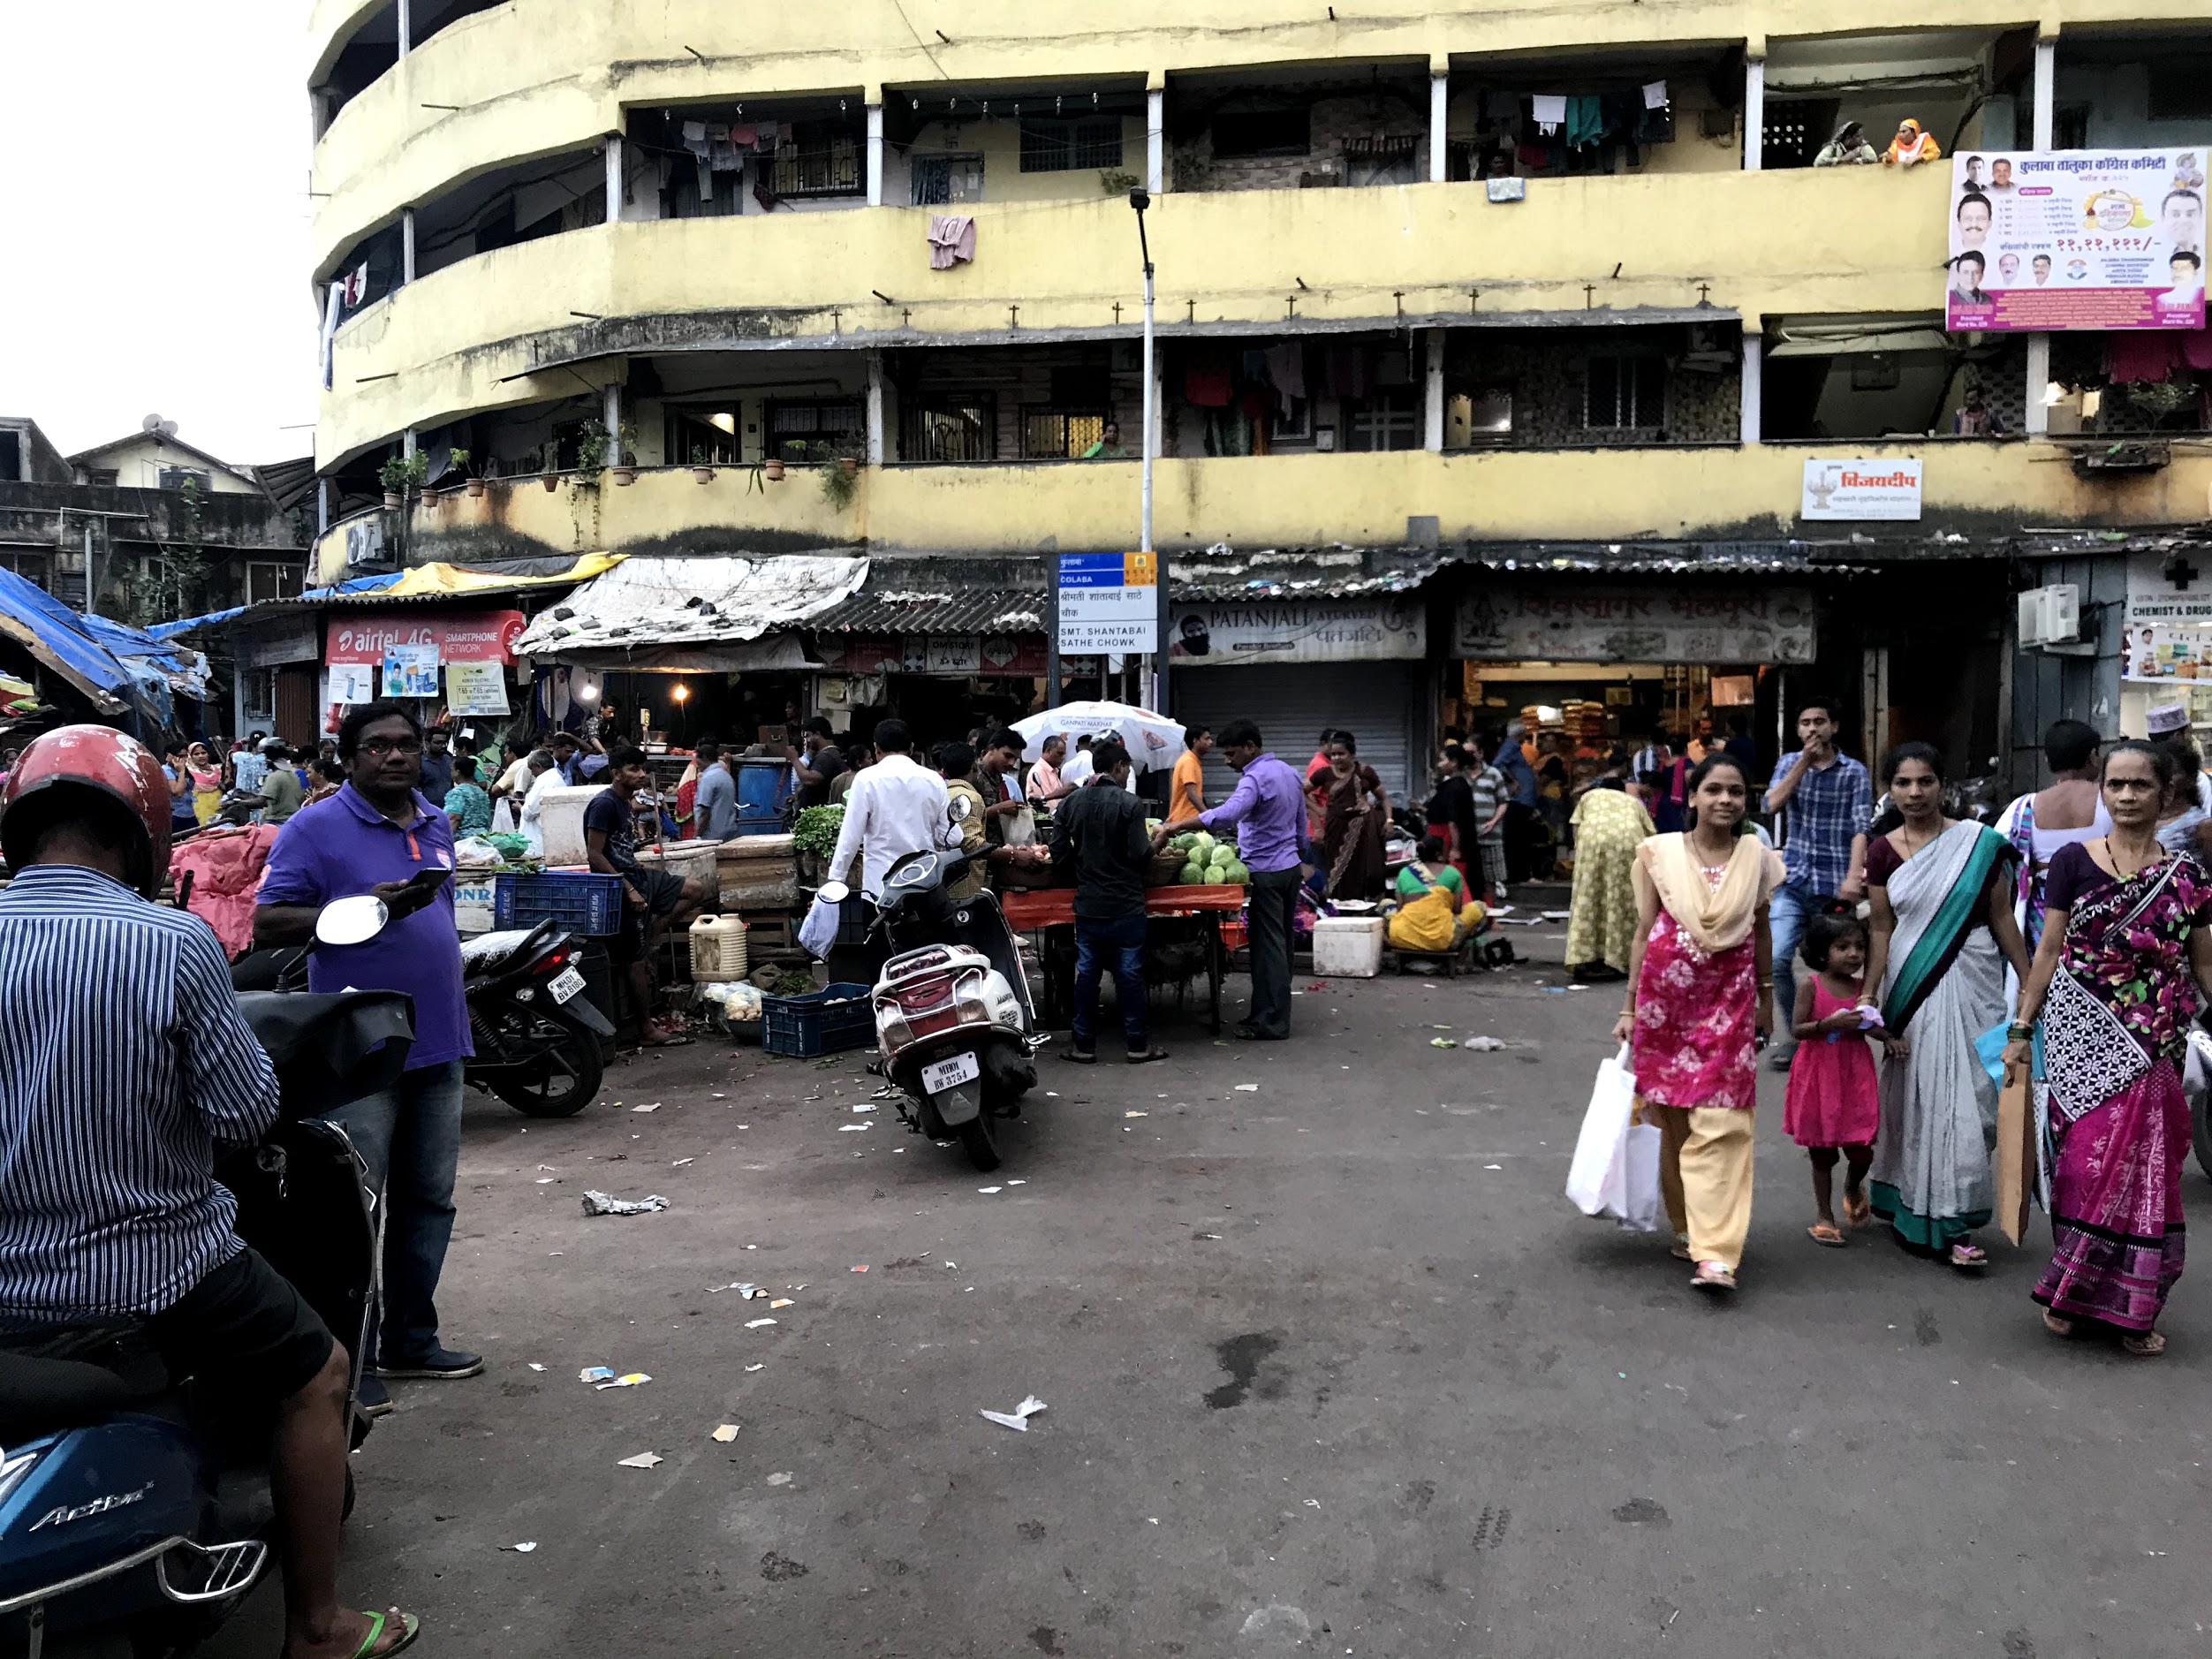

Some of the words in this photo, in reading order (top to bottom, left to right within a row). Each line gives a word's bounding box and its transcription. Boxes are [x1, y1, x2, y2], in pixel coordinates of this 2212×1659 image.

[2020, 160, 2054, 175] कुलाबा
[2057, 159, 2093, 174] तालुका
[2132, 155, 2166, 170] कमिटी
[1841, 471, 1916, 488] विजयदीप
[1060, 575, 1093, 584] COLABA
[1060, 590, 1085, 602] श्रीमती
[1088, 589, 1122, 602] शांताबाई
[1126, 589, 1142, 600] साठे
[2132, 606, 2175, 617] CHEMIST
[2177, 606, 2184, 616] &
[1210, 608, 1311, 631] PATANJALI
[1087, 626, 1147, 636] SHANTABAI
[444, 632, 498, 642] SMARTPHONE
[1097, 638, 1136, 647] CHOWK
[444, 643, 482, 654] NETWORK
[932, 640, 947, 649] OM
[949, 640, 975, 650] STORE
[946, 1069, 968, 1086] 3754
